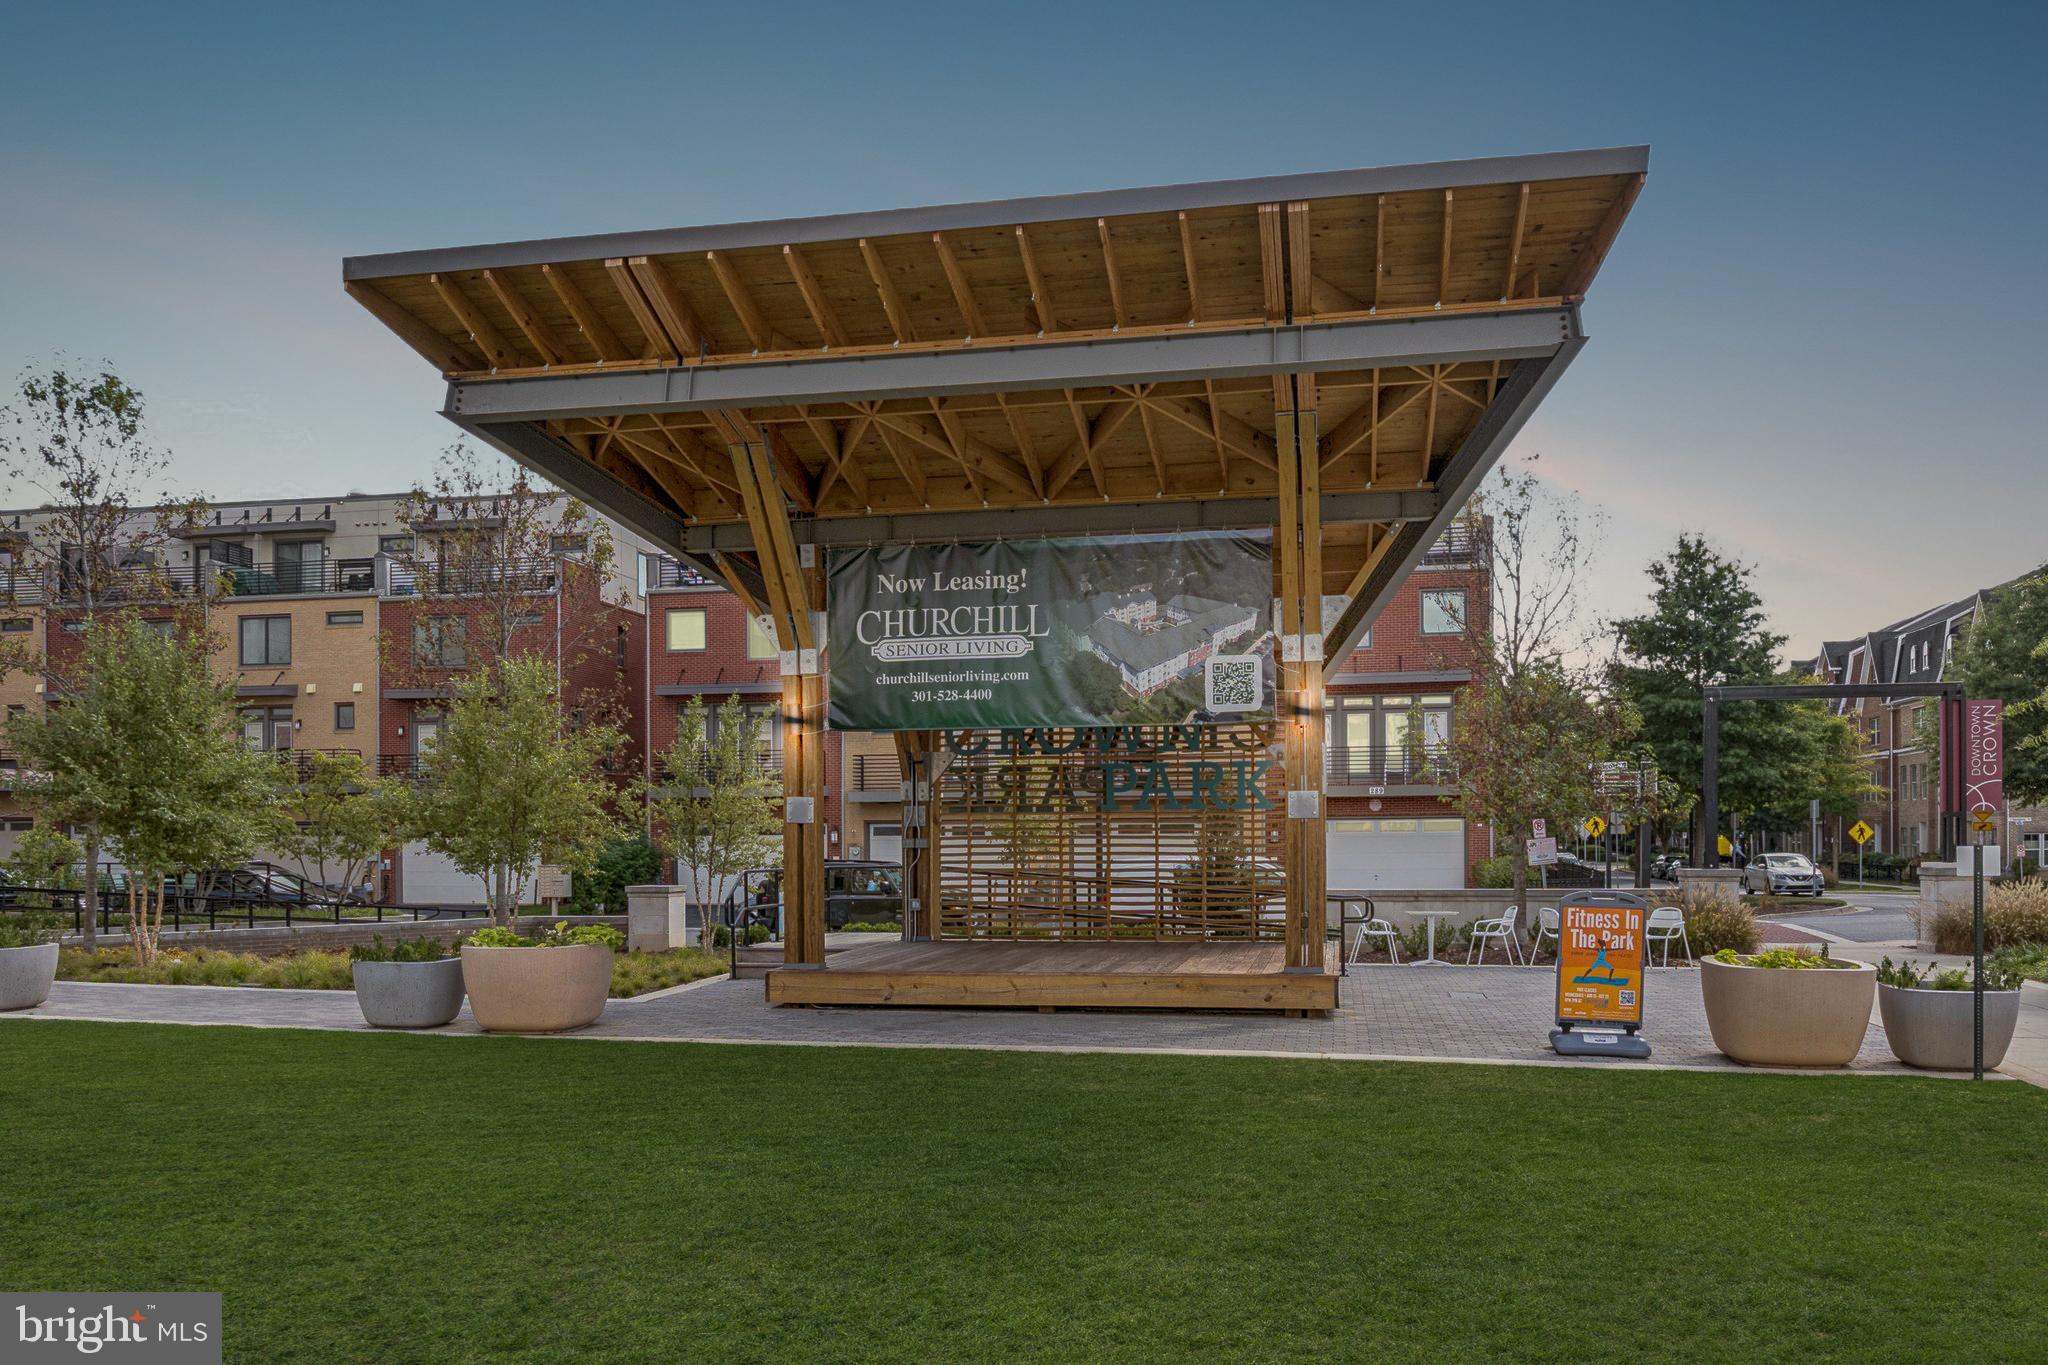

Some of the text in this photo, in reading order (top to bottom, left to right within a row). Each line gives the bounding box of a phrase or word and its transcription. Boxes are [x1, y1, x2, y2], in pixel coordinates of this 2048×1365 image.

[877, 568, 1027, 594] Now Leasing!
[856, 604, 1050, 645] CHURCHILL
[886, 640, 1018, 657] SENIOR LIVING
[876, 670, 1029, 685] churchillseniorliving.com
[911, 689, 992, 702] 301-528-4400
[1971, 705, 1981, 776] DOWNTOWN
[1983, 705, 1997, 776] CROWN
[1102, 760, 1276, 812] PARK
[1567, 907, 1639, 930] Fitness In
[1570, 928, 1634, 951] The Park
